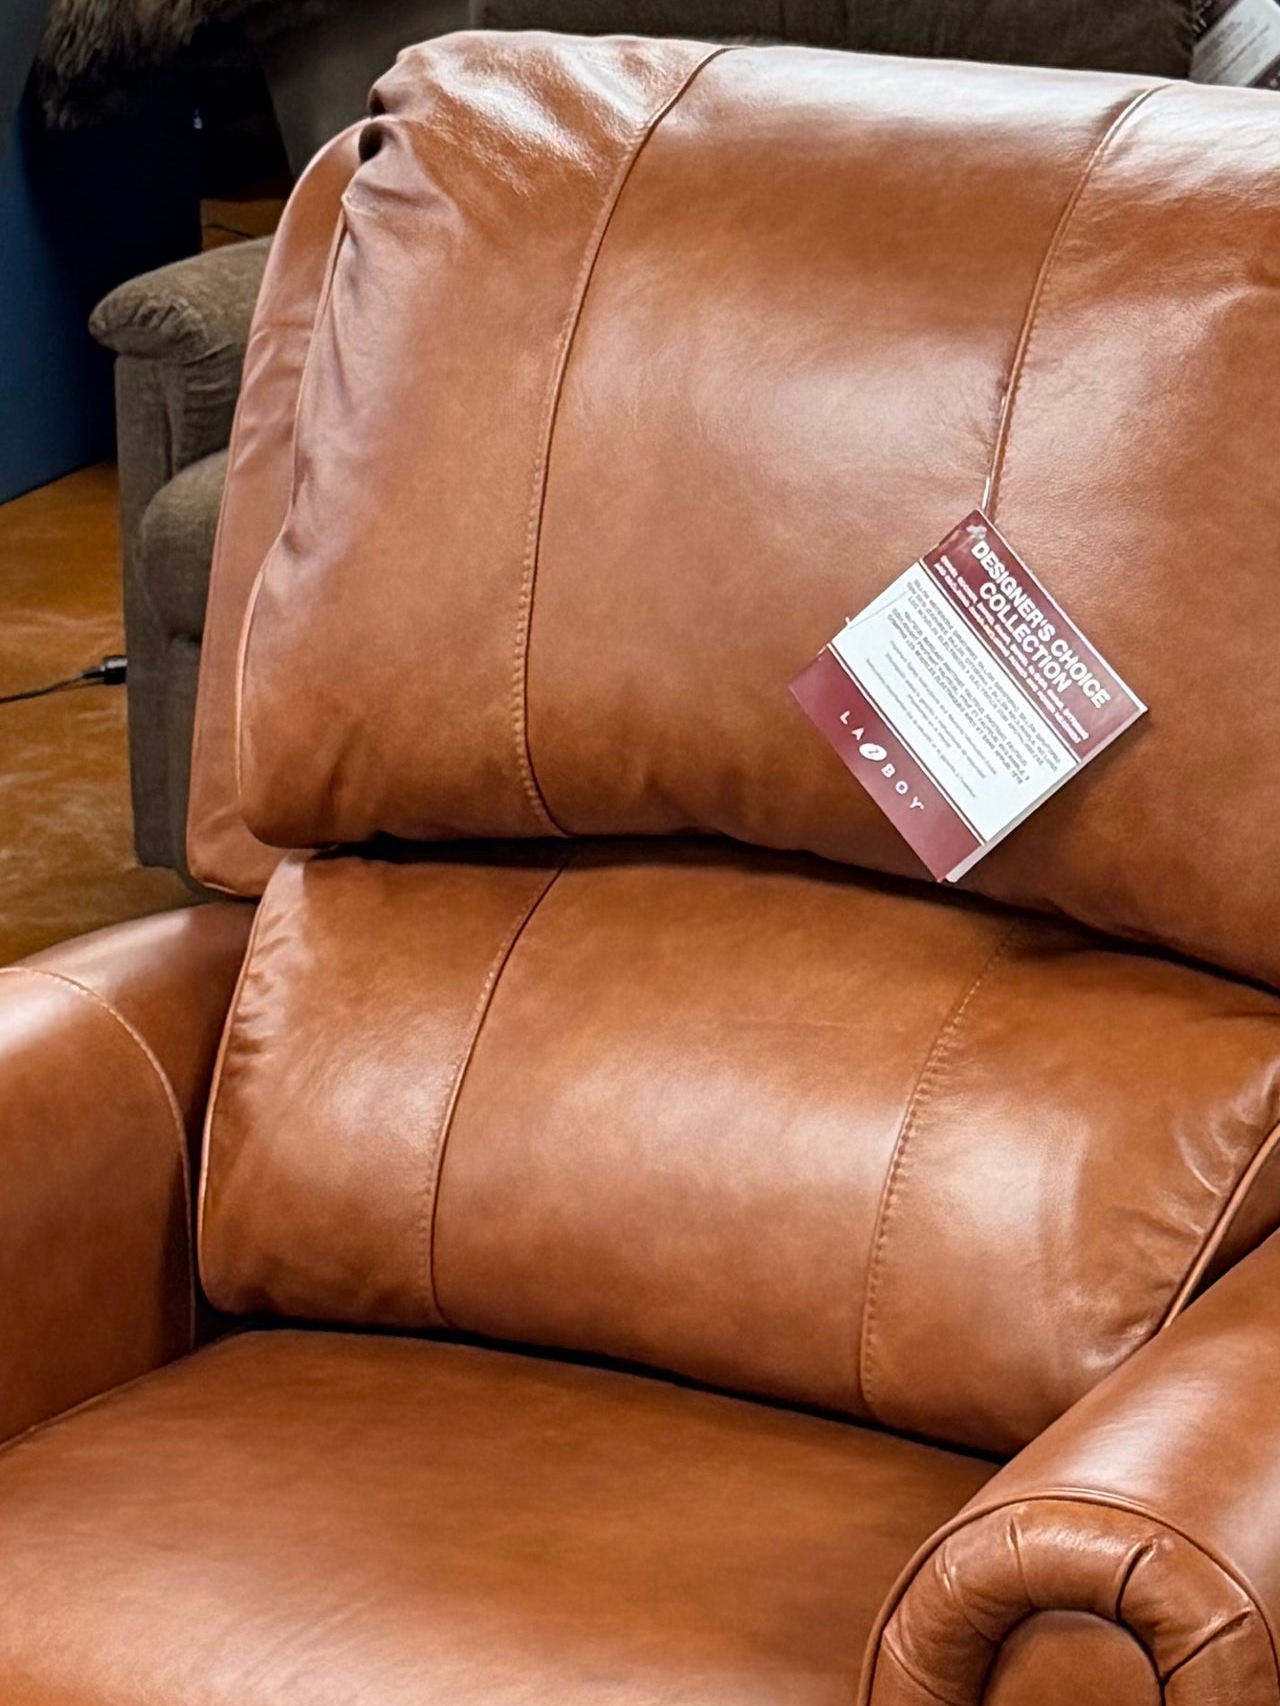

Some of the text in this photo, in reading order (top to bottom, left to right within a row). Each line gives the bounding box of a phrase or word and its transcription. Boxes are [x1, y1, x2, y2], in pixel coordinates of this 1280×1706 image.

[971, 540, 1055, 641] DESIGNER'S
[1051, 638, 1111, 708] CHOICE
[979, 582, 1072, 693] COLLECTION
